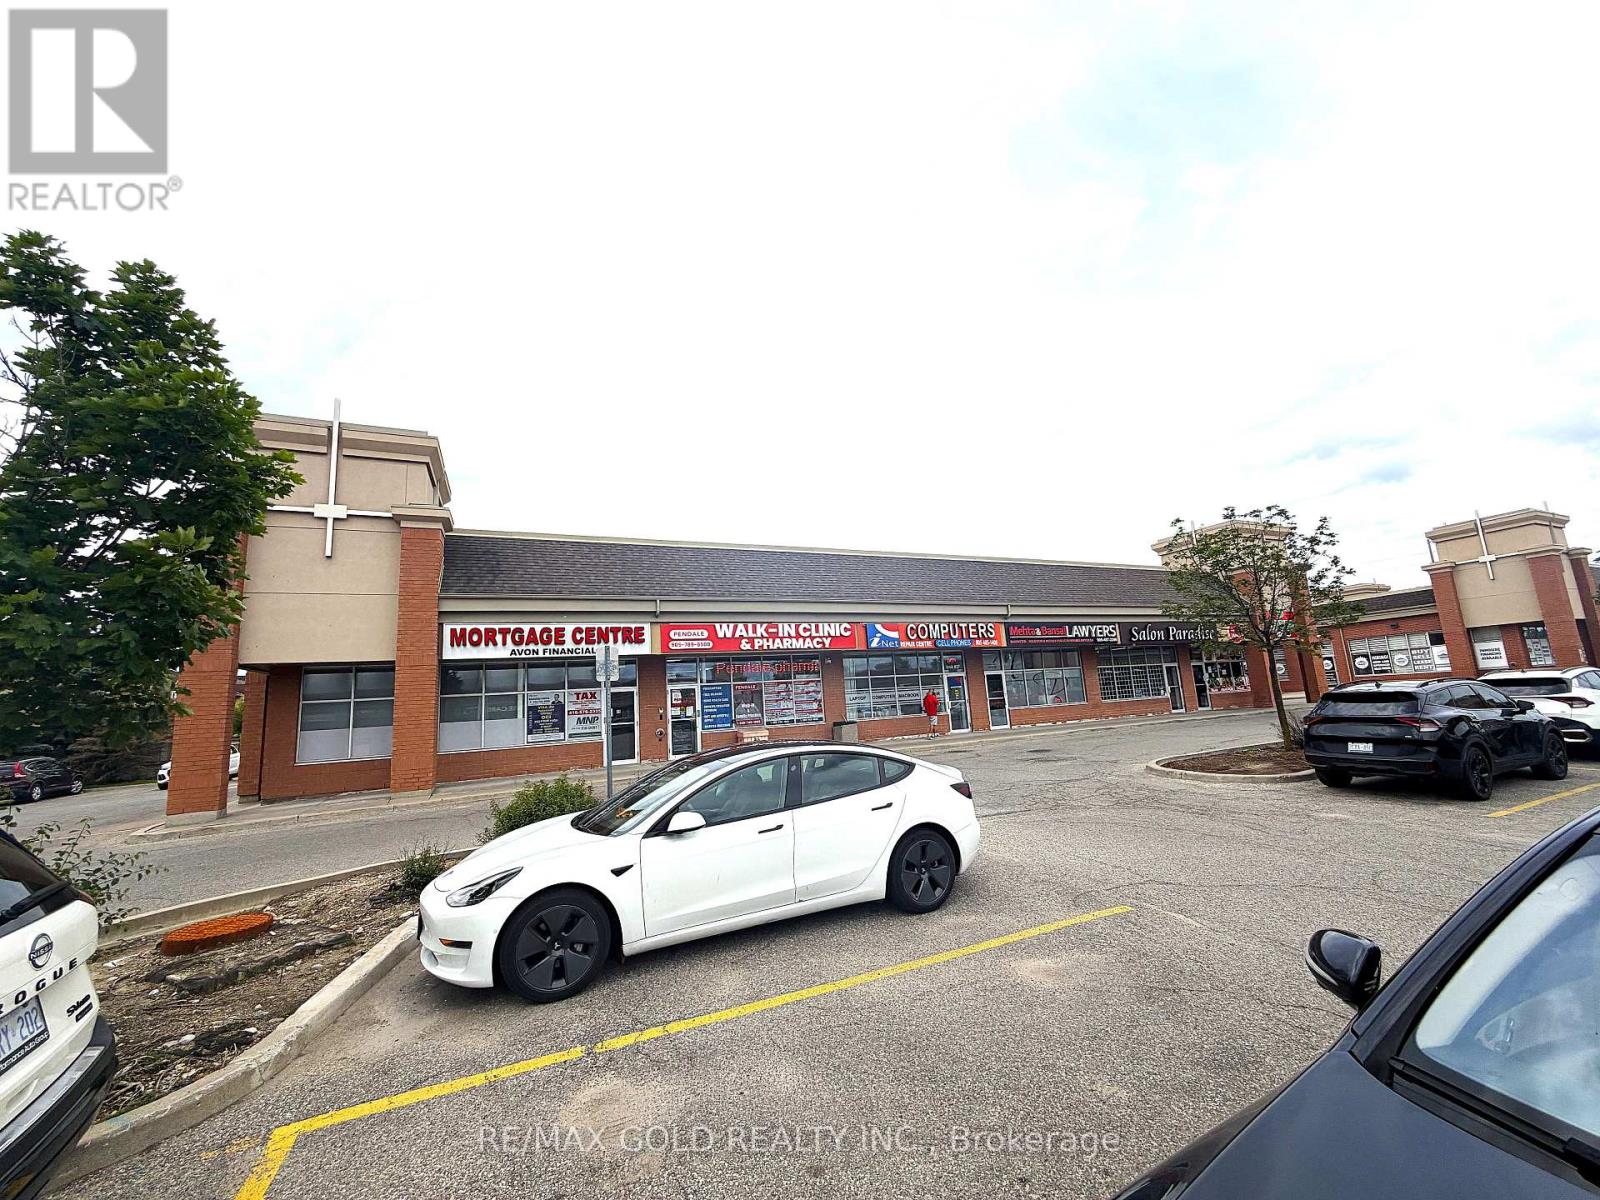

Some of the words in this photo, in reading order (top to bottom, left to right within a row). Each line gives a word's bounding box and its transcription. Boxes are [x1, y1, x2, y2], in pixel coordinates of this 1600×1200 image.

[450, 627, 566, 647] MORTGAGE
[571, 626, 645, 645] CENTRE
[715, 623, 795, 638] WALK-IN
[799, 623, 852, 637] CLINIC
[907, 623, 996, 639] COMPUTERS
[1066, 625, 1117, 637] LAWYERS
[1131, 624, 1165, 641] Salon
[510, 648, 539, 656] AVON
[542, 647, 597, 656] FINANCIAL
[740, 638, 751, 650] &
[754, 638, 832, 649] PHARMACY
[574, 692, 597, 700] TAX
[17, 1006, 42, 1041] 202
